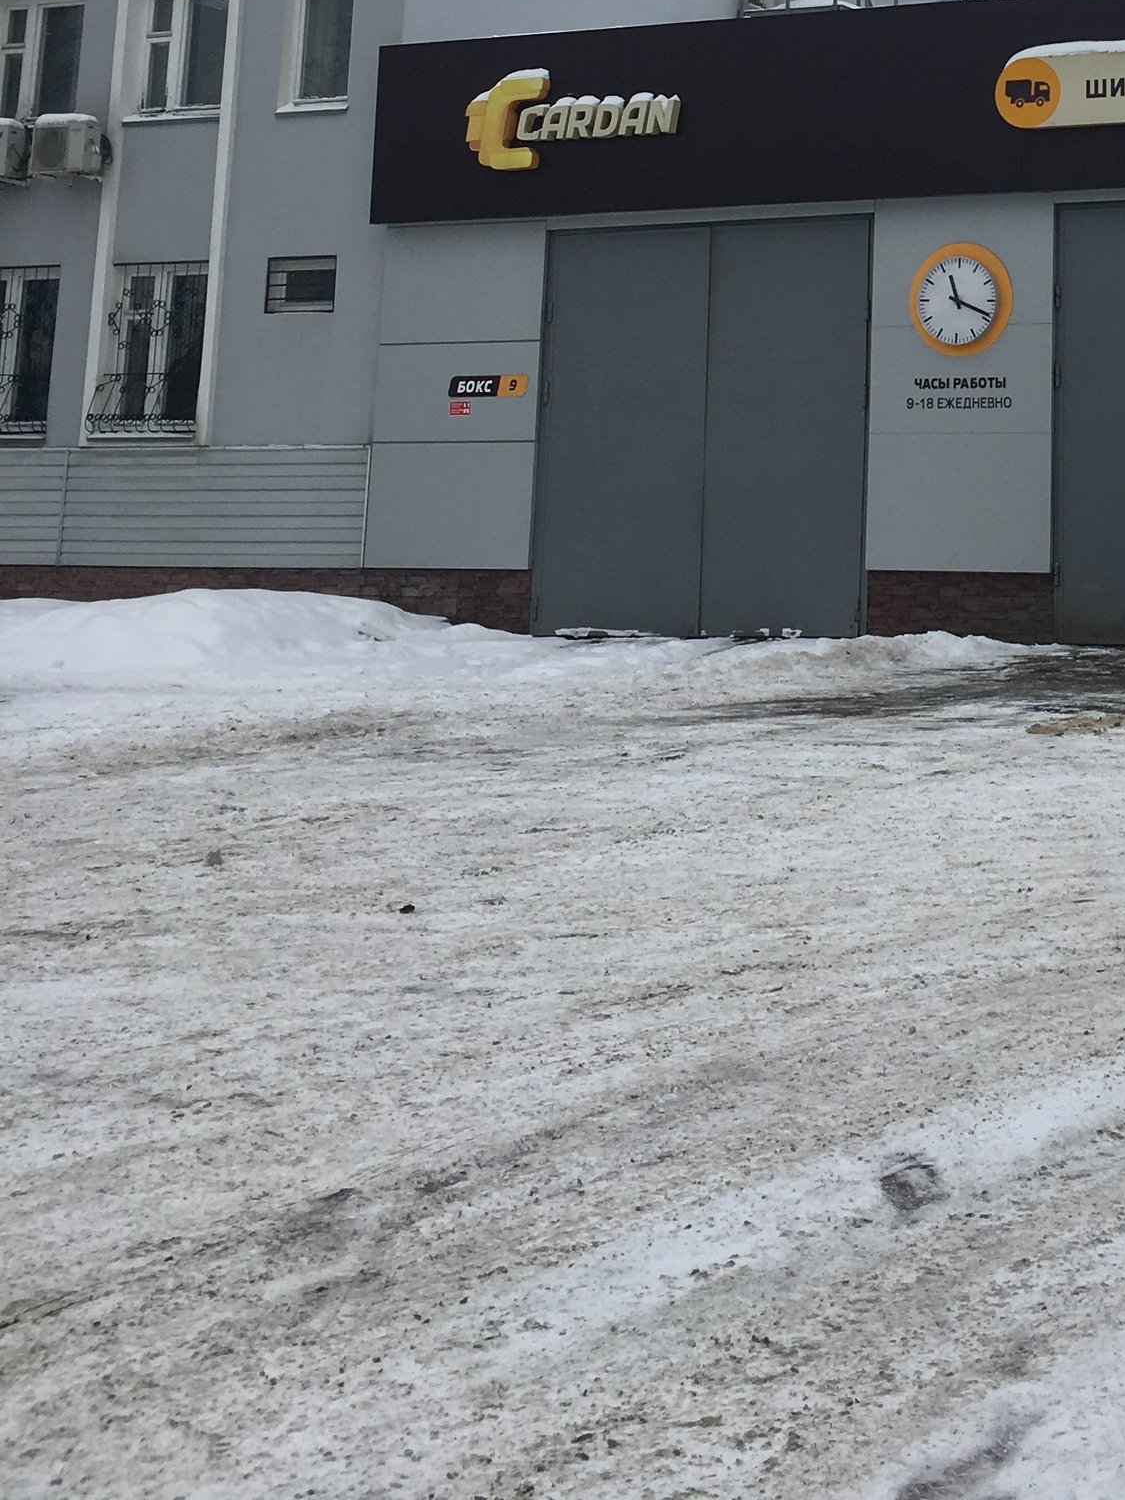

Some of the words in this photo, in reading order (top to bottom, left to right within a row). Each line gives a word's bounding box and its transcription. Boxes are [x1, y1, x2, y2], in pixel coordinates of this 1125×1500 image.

[516, 95, 682, 142] CARDAN
[456, 380, 493, 393] БОКС
[508, 379, 518, 391] 9
[914, 377, 950, 389] ЧАСЫ
[953, 377, 1007, 389] РАБОТЫ
[906, 397, 934, 409] 9-18
[937, 396, 1012, 410] ЕЖЕДНЕВНО
